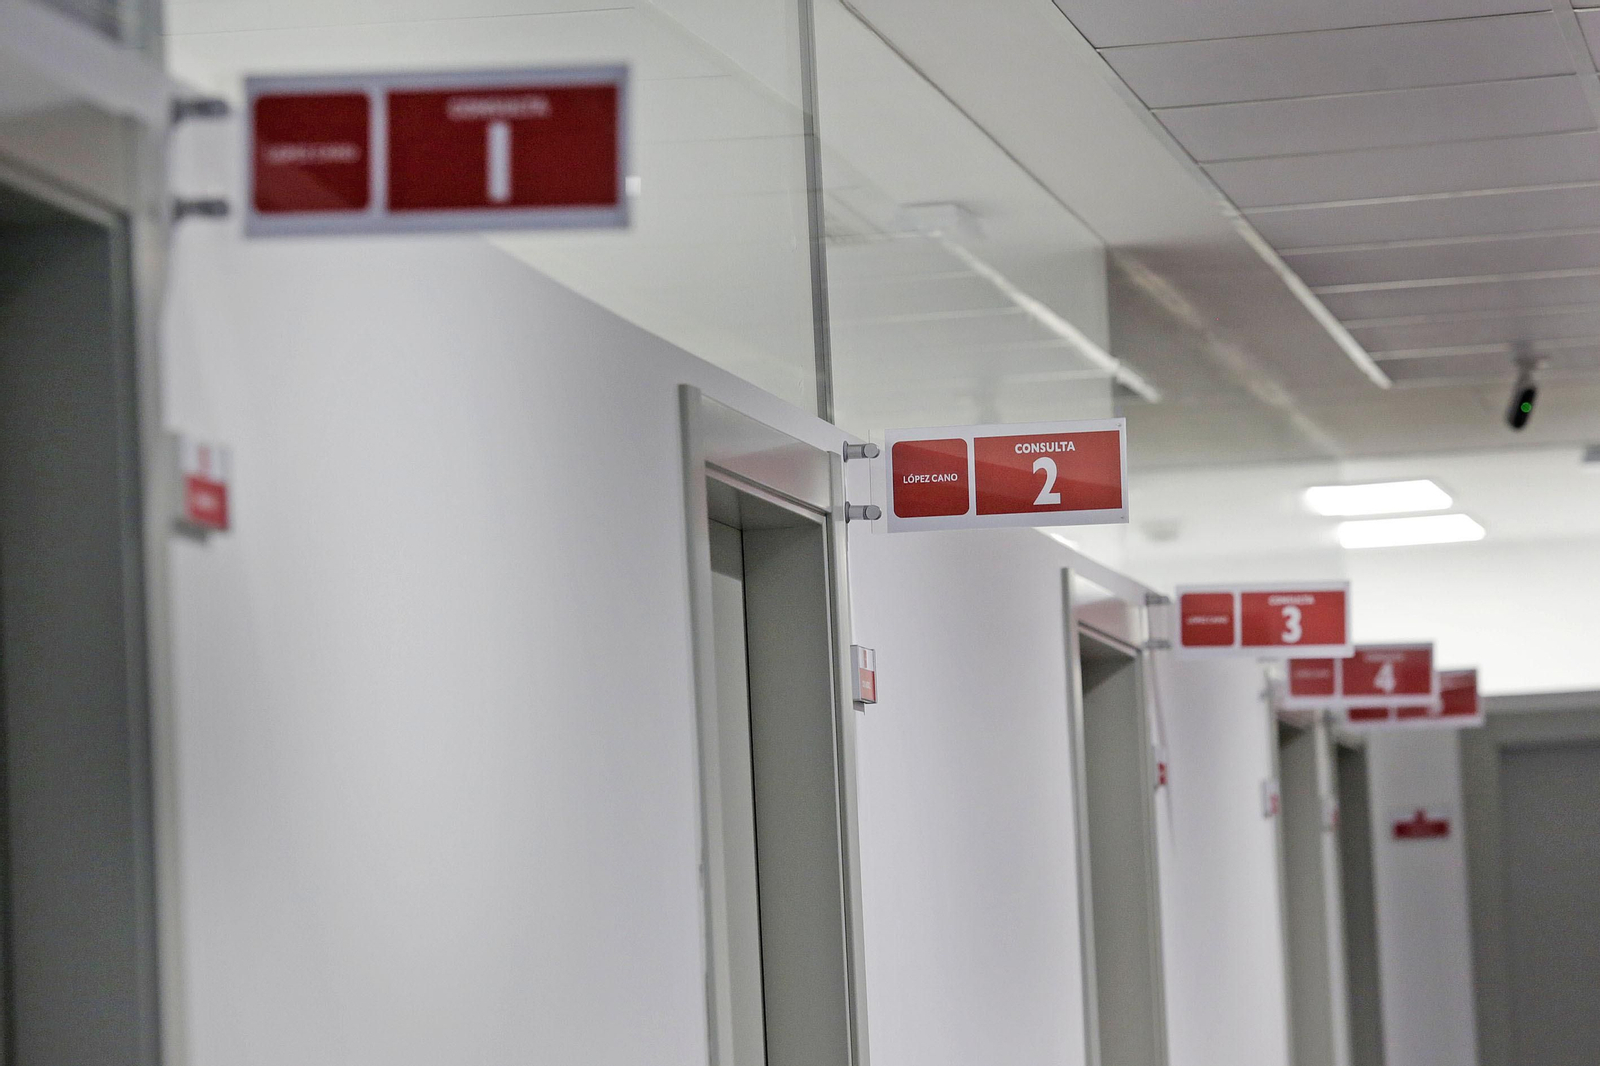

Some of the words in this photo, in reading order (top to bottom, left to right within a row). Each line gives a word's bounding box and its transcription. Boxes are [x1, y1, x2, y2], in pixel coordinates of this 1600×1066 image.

[1014, 441, 1076, 454] CONSULTA
[903, 473, 930, 484] LÓPEZ
[931, 473, 958, 483] CANO
[1032, 456, 1061, 506] 2
[1281, 605, 1303, 644] 3
[1373, 661, 1396, 693] 4
